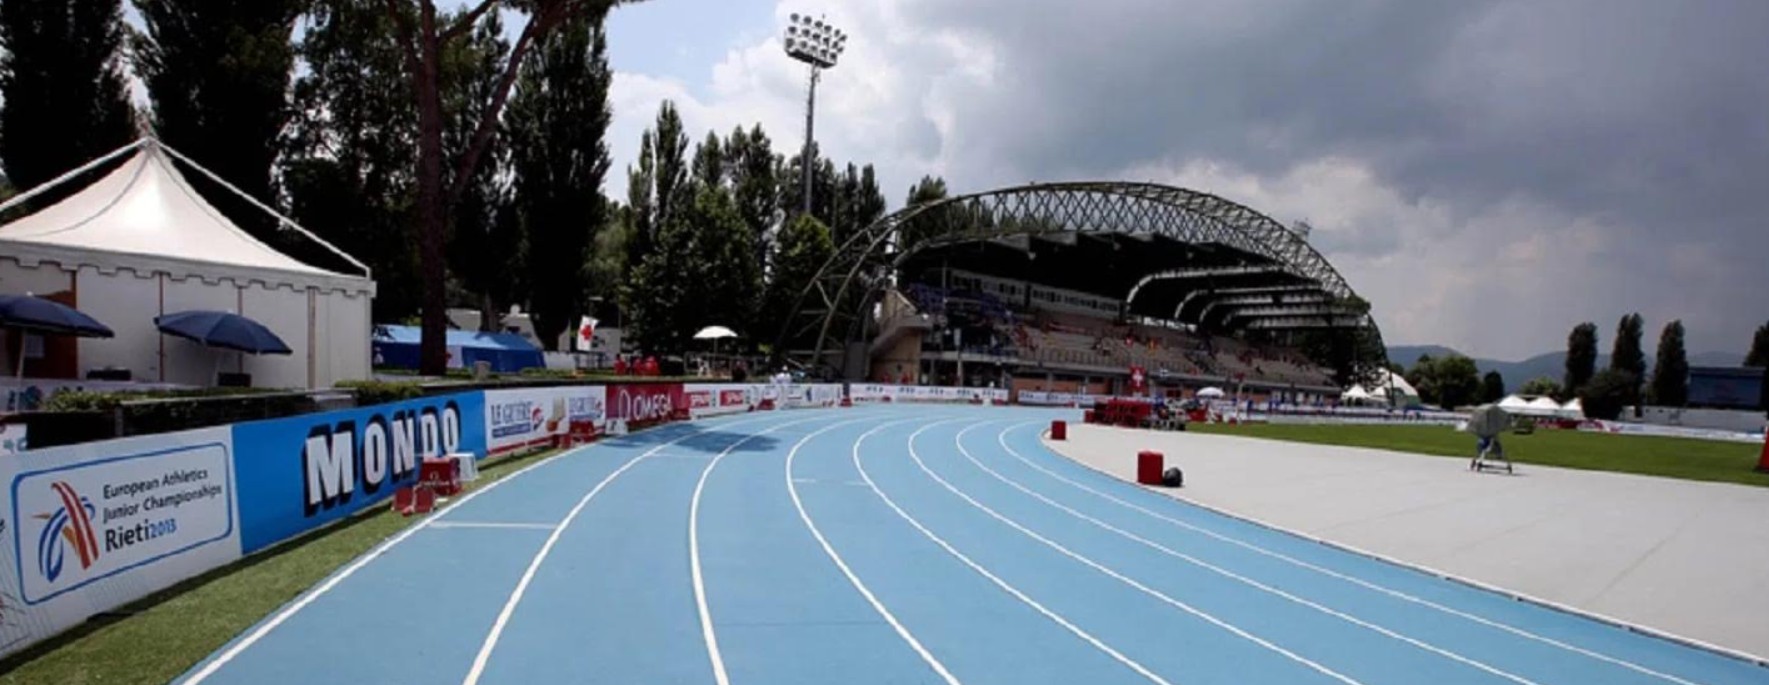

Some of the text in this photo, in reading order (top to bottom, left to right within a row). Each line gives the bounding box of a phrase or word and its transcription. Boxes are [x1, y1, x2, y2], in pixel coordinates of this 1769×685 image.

[633, 393, 672, 420] OMEGA
[304, 406, 461, 506] MONDO
[103, 469, 208, 499] European Athletics
[103, 485, 222, 524] Junior Championships
